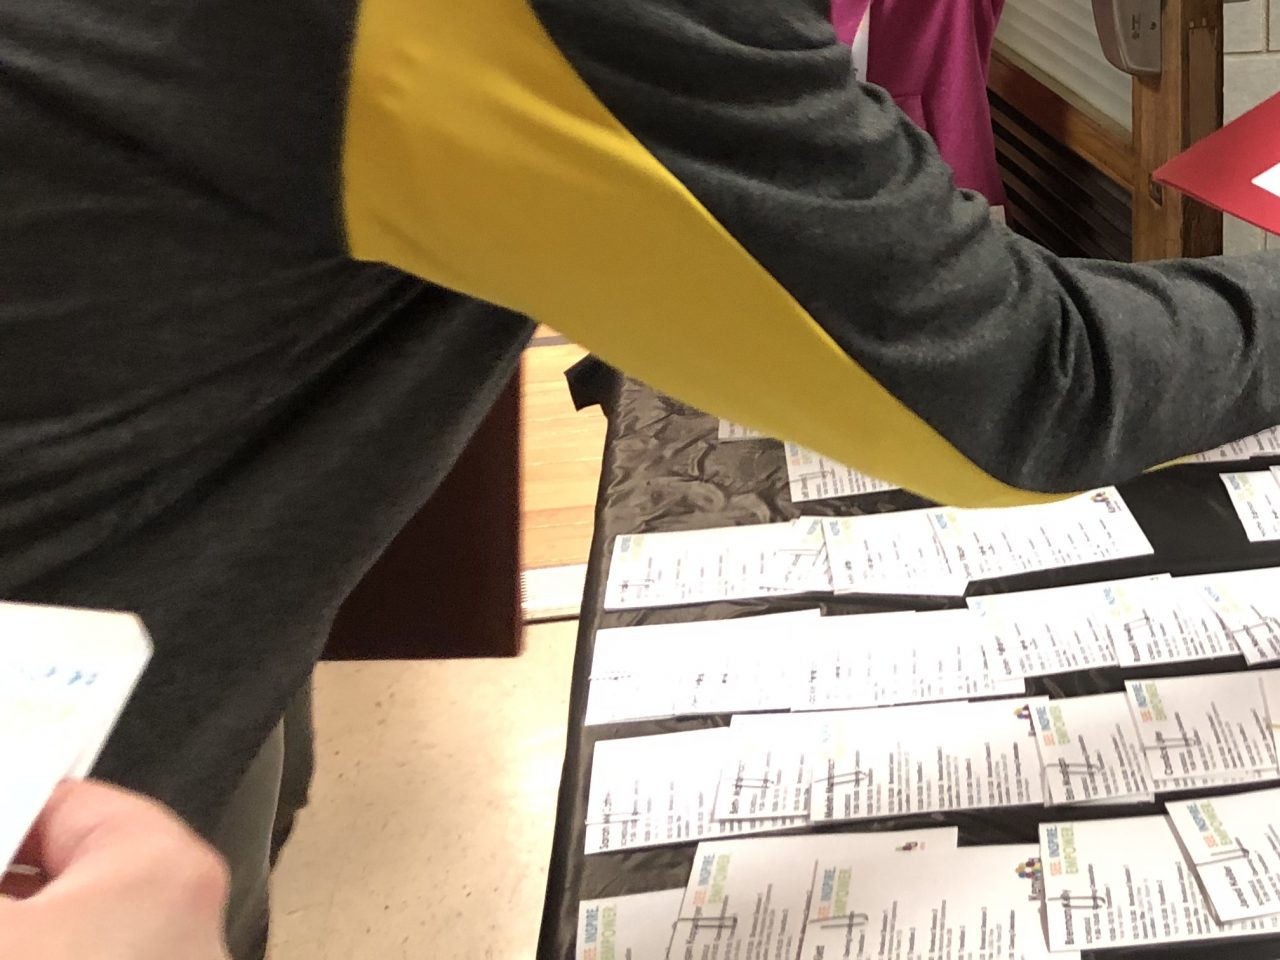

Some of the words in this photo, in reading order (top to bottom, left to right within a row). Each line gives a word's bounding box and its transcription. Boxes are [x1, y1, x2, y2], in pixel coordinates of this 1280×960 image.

[1046, 825, 1058, 856] INSPIRE.
[698, 853, 714, 885] INSPIRE.
[585, 905, 599, 944] INSPIRE.
